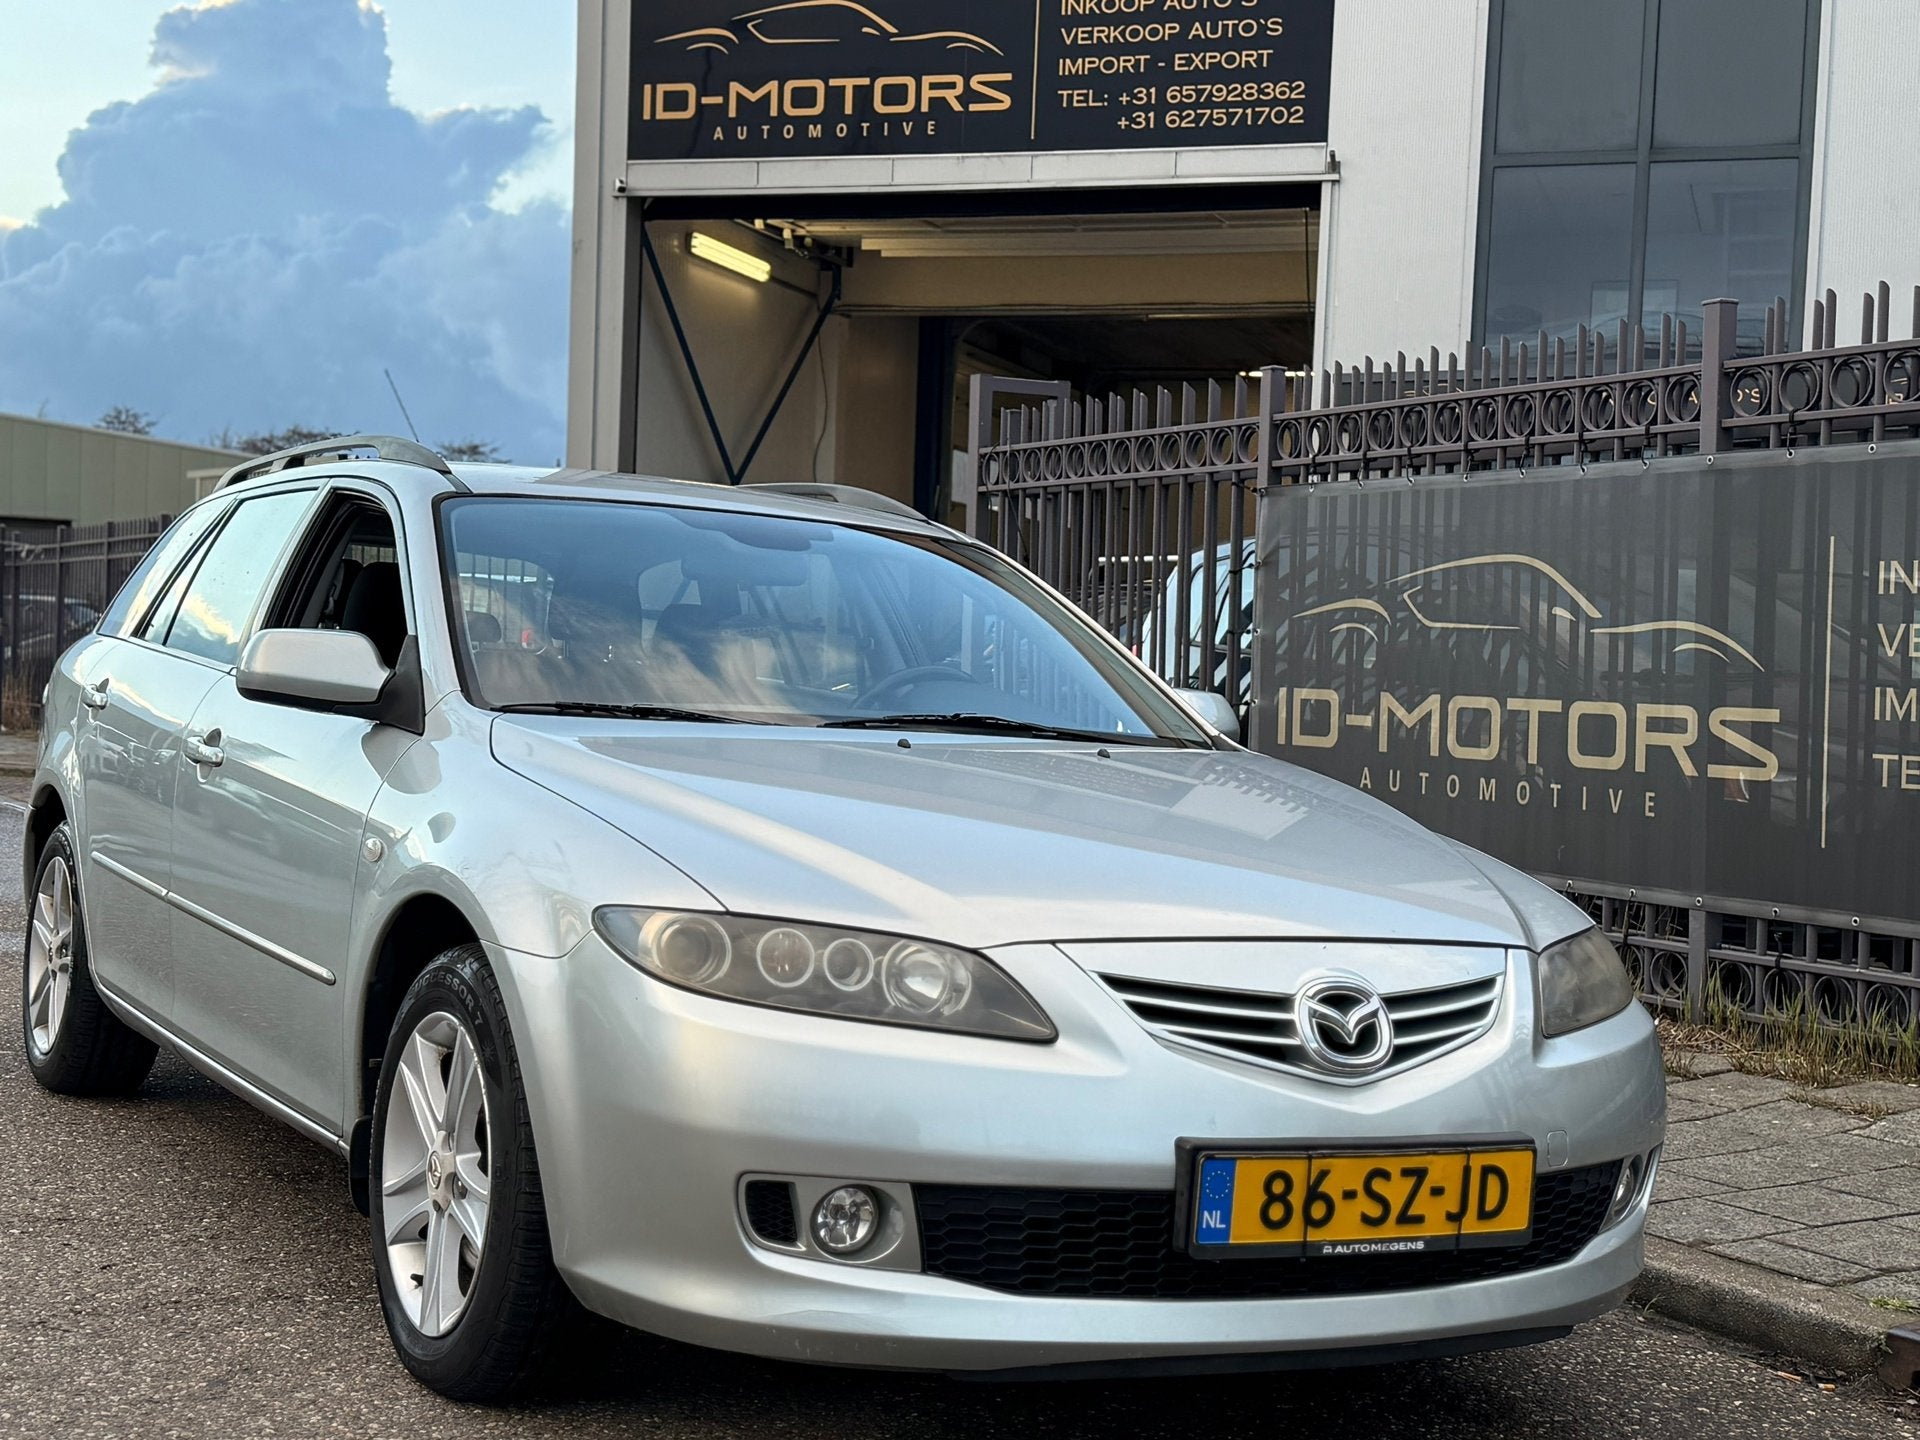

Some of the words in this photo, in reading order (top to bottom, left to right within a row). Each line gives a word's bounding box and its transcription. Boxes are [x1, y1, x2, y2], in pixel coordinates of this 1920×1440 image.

[1061, 0, 1155, 15] INKOOP
[1061, 23, 1180, 45] VERKOOP
[1058, 55, 1151, 76] IMPORT
[1174, 50, 1273, 72] EXPORT
[643, 73, 1013, 120] ID-MOTORS
[1058, 89, 1108, 108] TEL:
[1118, 87, 1156, 106] +31
[1166, 81, 1306, 104] 657928362
[1117, 111, 1155, 129] +31
[1165, 106, 1305, 128] 627571702
[713, 121, 936, 141] AUTOMOTIVE
[1277, 687, 1781, 782] ID-MOTORS
[1359, 766, 1655, 817] AUTOMOTIVE
[1260, 1164, 1509, 1230] 86-SZ-JD
[1202, 1209, 1226, 1229] NL
[1334, 1241, 1425, 1254] AUTOMEGENS
